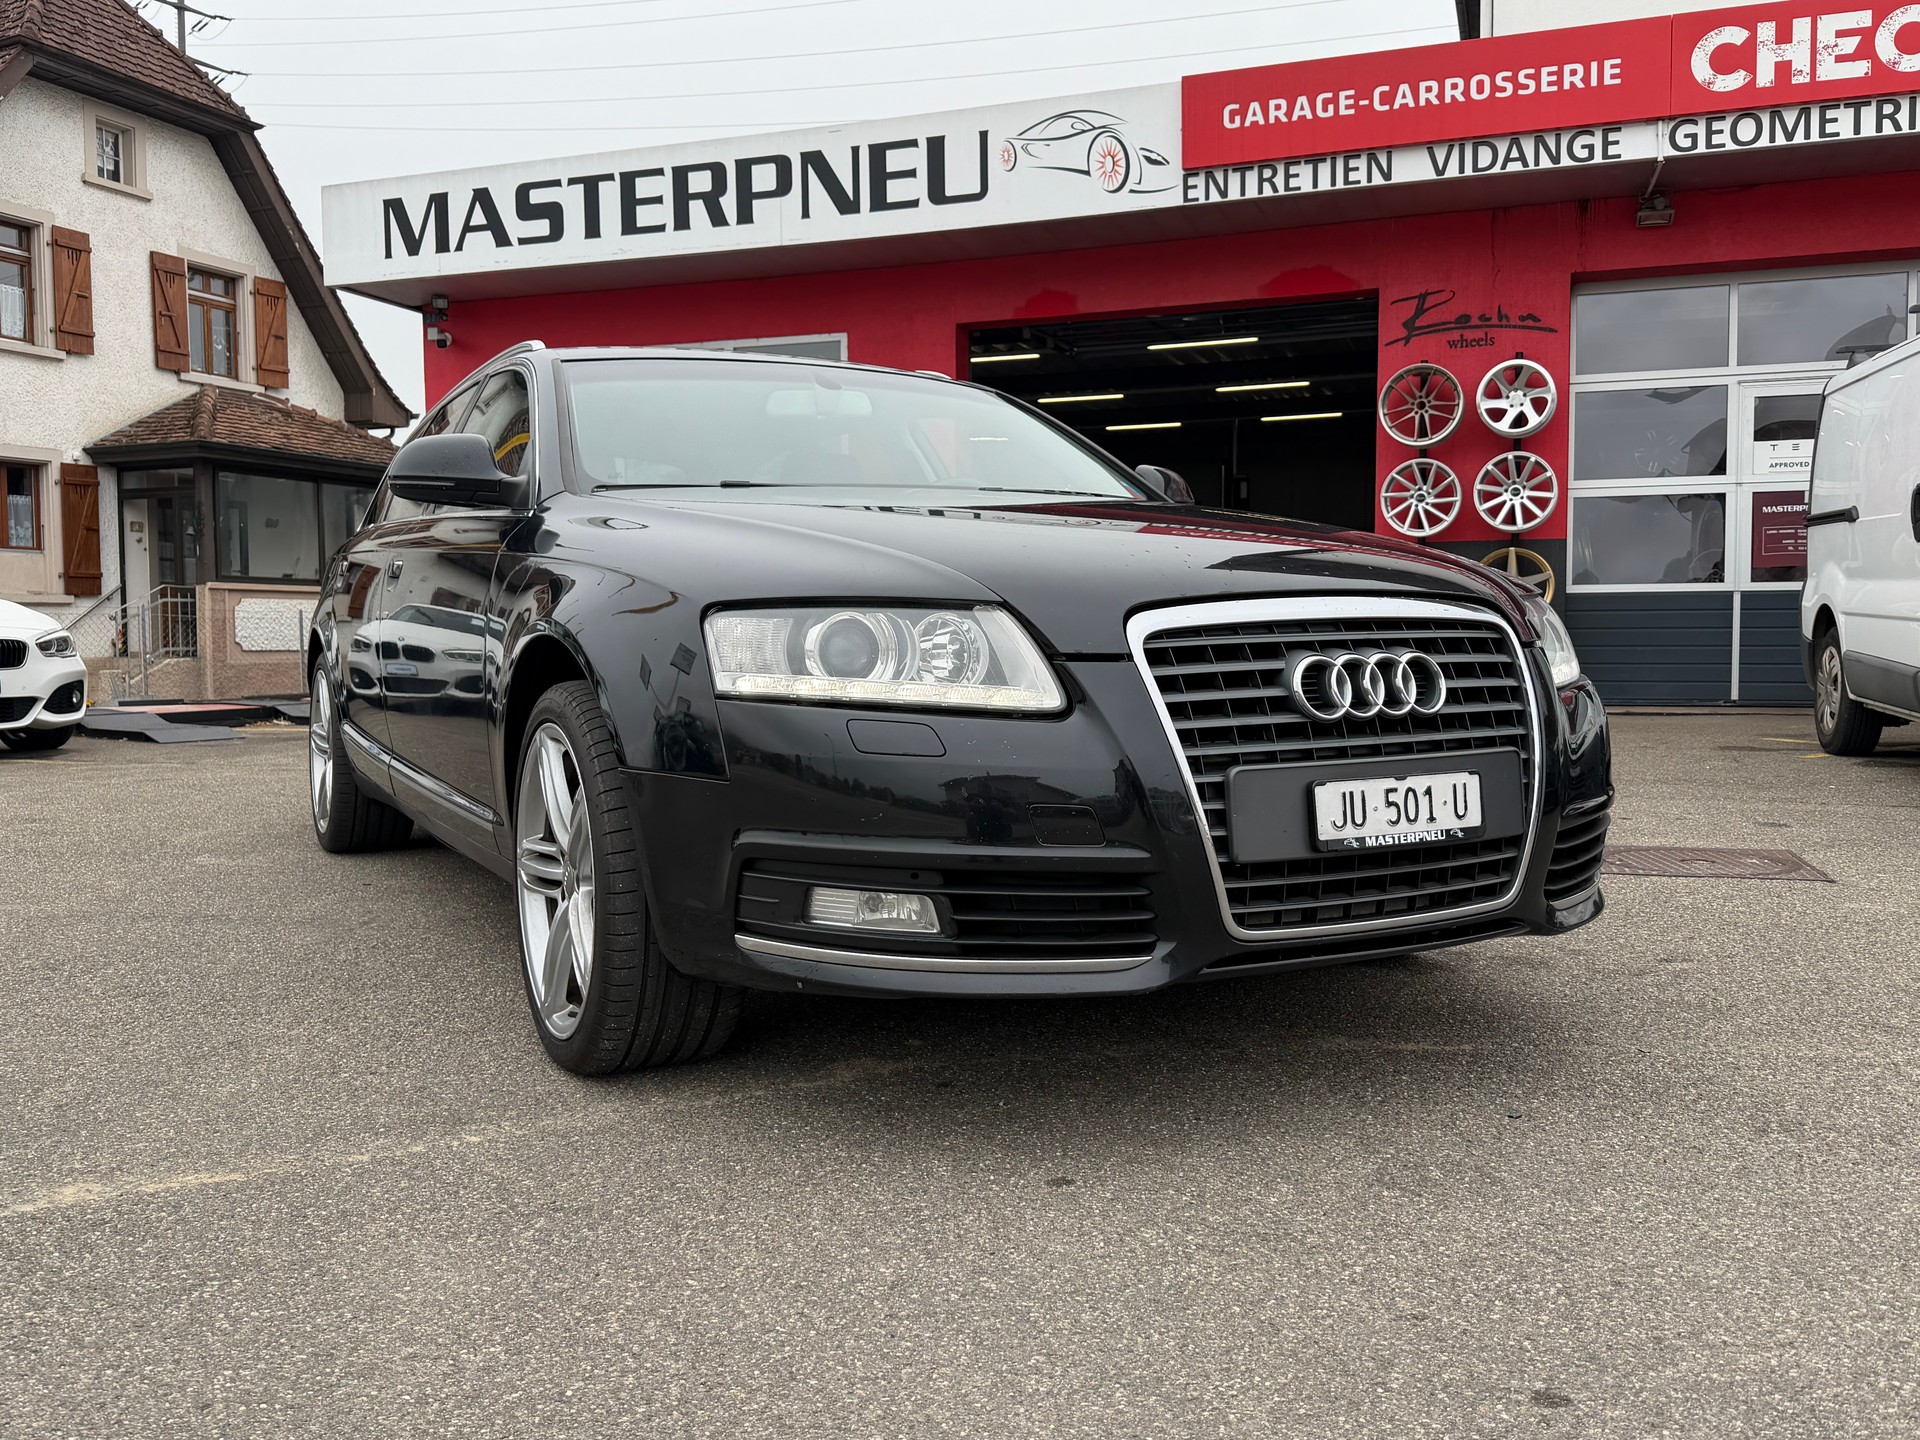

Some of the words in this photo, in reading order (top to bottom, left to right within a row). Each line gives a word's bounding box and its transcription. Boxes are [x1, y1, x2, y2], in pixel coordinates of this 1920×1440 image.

[1222, 57, 1622, 130] GARAGE-CARROSSERIE
[1182, 150, 1394, 204] ENTRETIEN
[1426, 127, 1623, 178] VIDANGE
[382, 129, 989, 260] MASTERPNEU
[1446, 331, 1496, 350] wheels
[1768, 461, 1810, 469] APPROVED
[1365, 830, 1446, 847] MASTERPNEU
